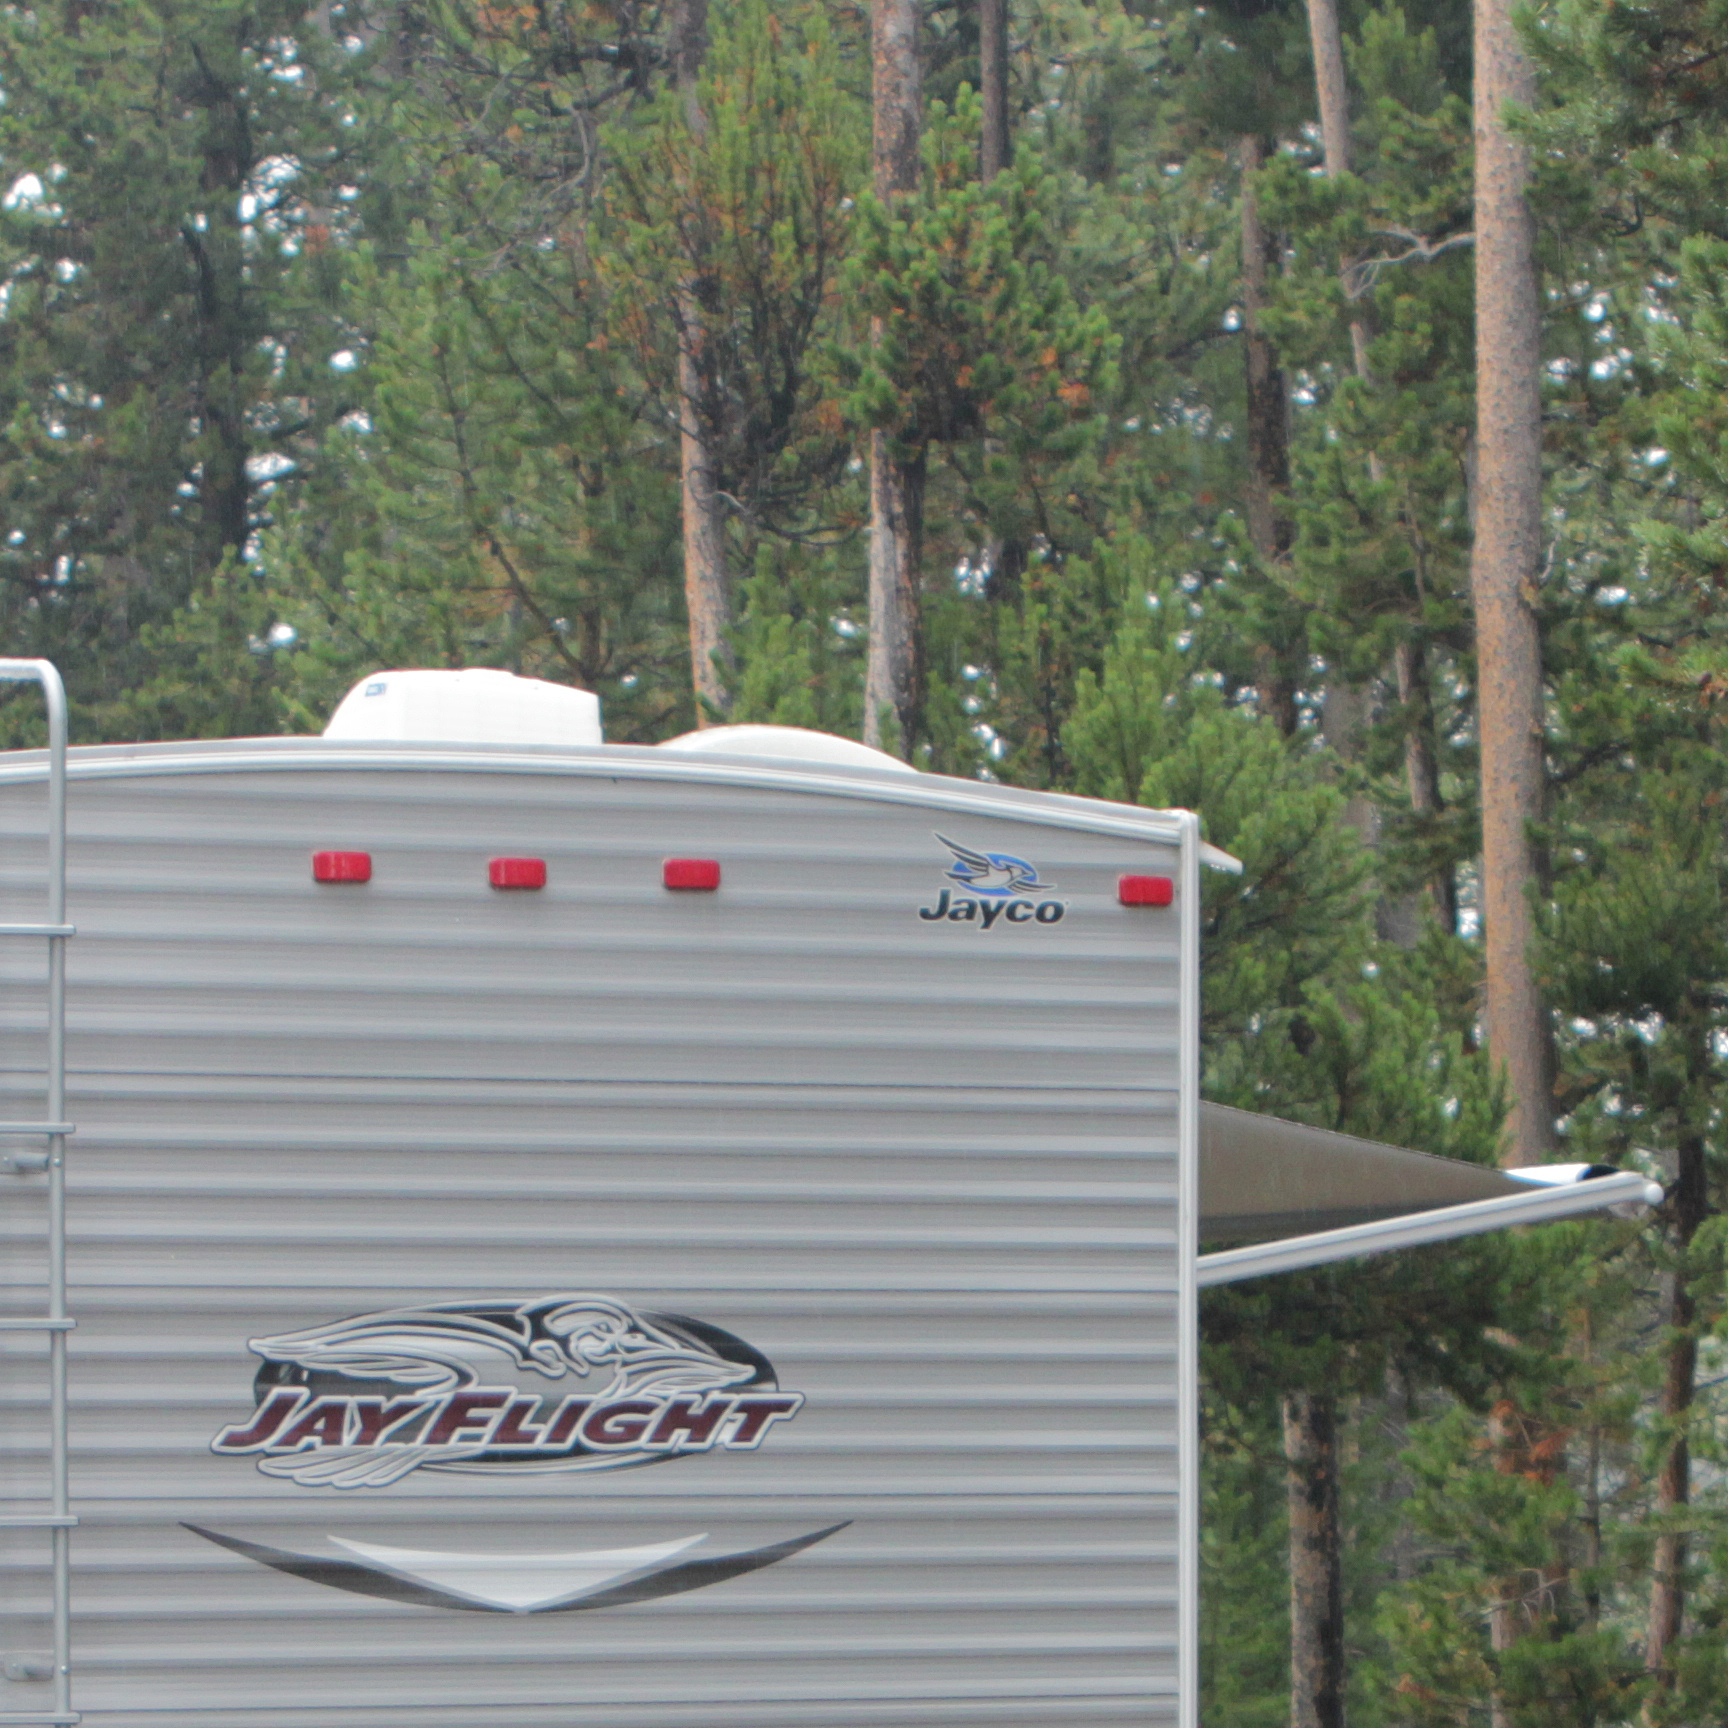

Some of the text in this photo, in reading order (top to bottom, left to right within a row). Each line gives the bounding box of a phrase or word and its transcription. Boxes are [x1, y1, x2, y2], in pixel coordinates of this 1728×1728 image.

[919, 888, 1065, 930] Jayco
[211, 1386, 806, 1455] JAY FLIGHT
